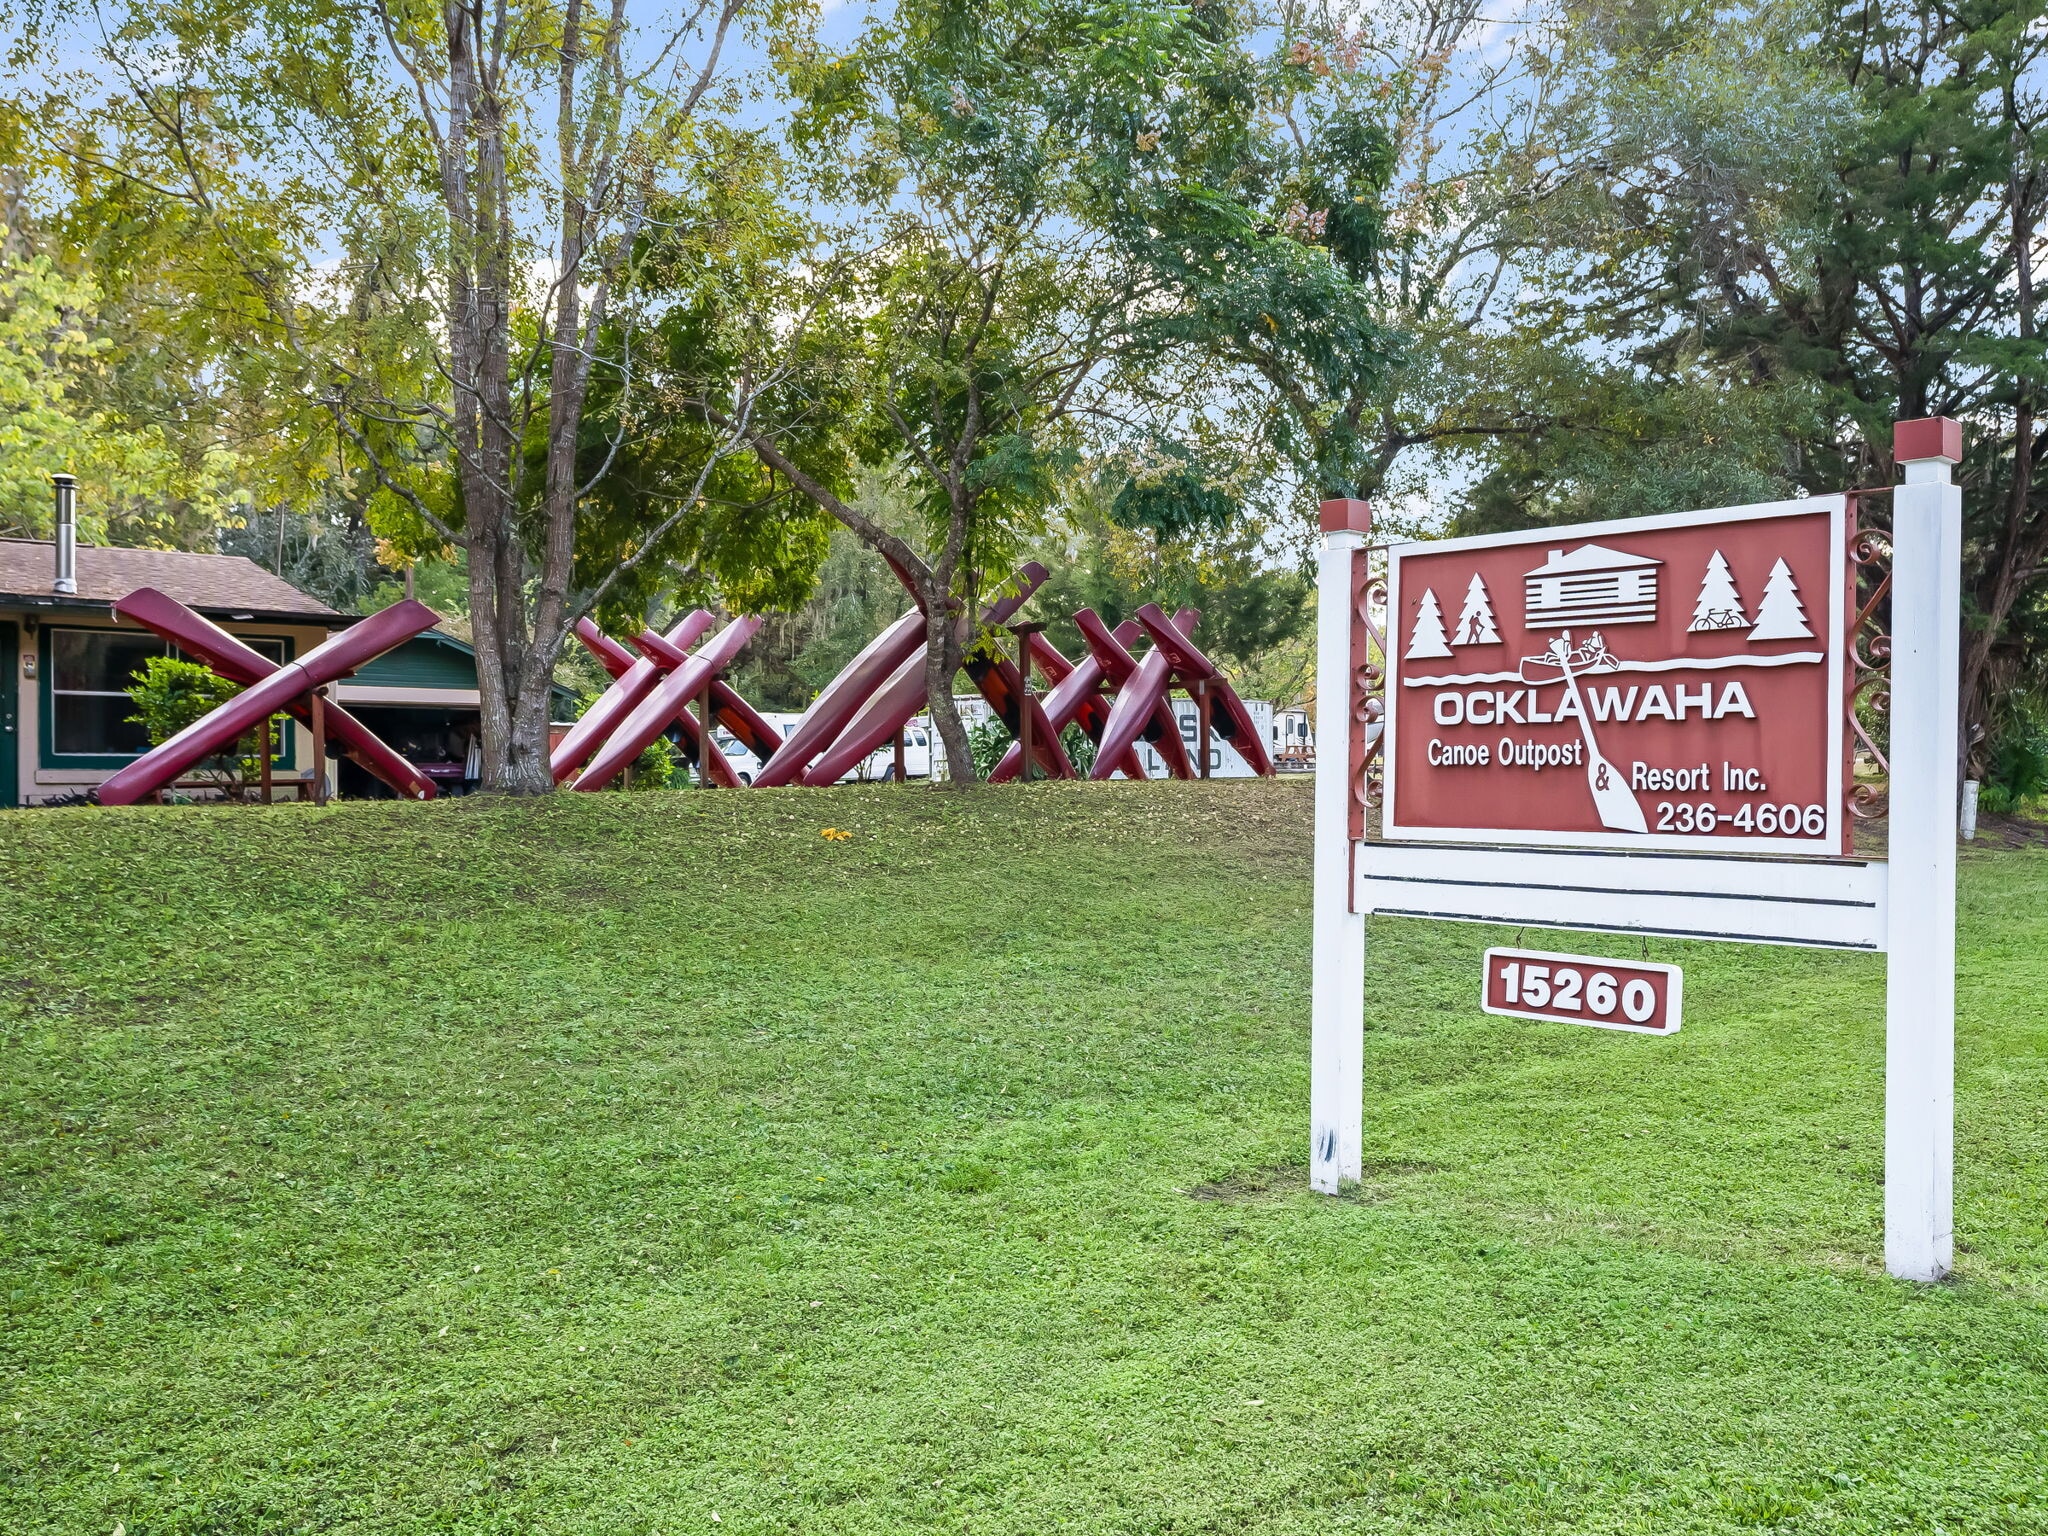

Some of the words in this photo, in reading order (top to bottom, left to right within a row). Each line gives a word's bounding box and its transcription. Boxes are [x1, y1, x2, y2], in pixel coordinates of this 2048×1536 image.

[1433, 680, 1757, 726] OCKLAWAHA
[1427, 738, 1490, 766] Canoe
[1497, 736, 1583, 771] Outpost
[1595, 763, 1611, 792] &
[1631, 761, 1710, 791] Resort
[1723, 761, 1767, 791] Inc.
[1656, 801, 1825, 835] 236-4606
[1500, 962, 1656, 1023] 15260
